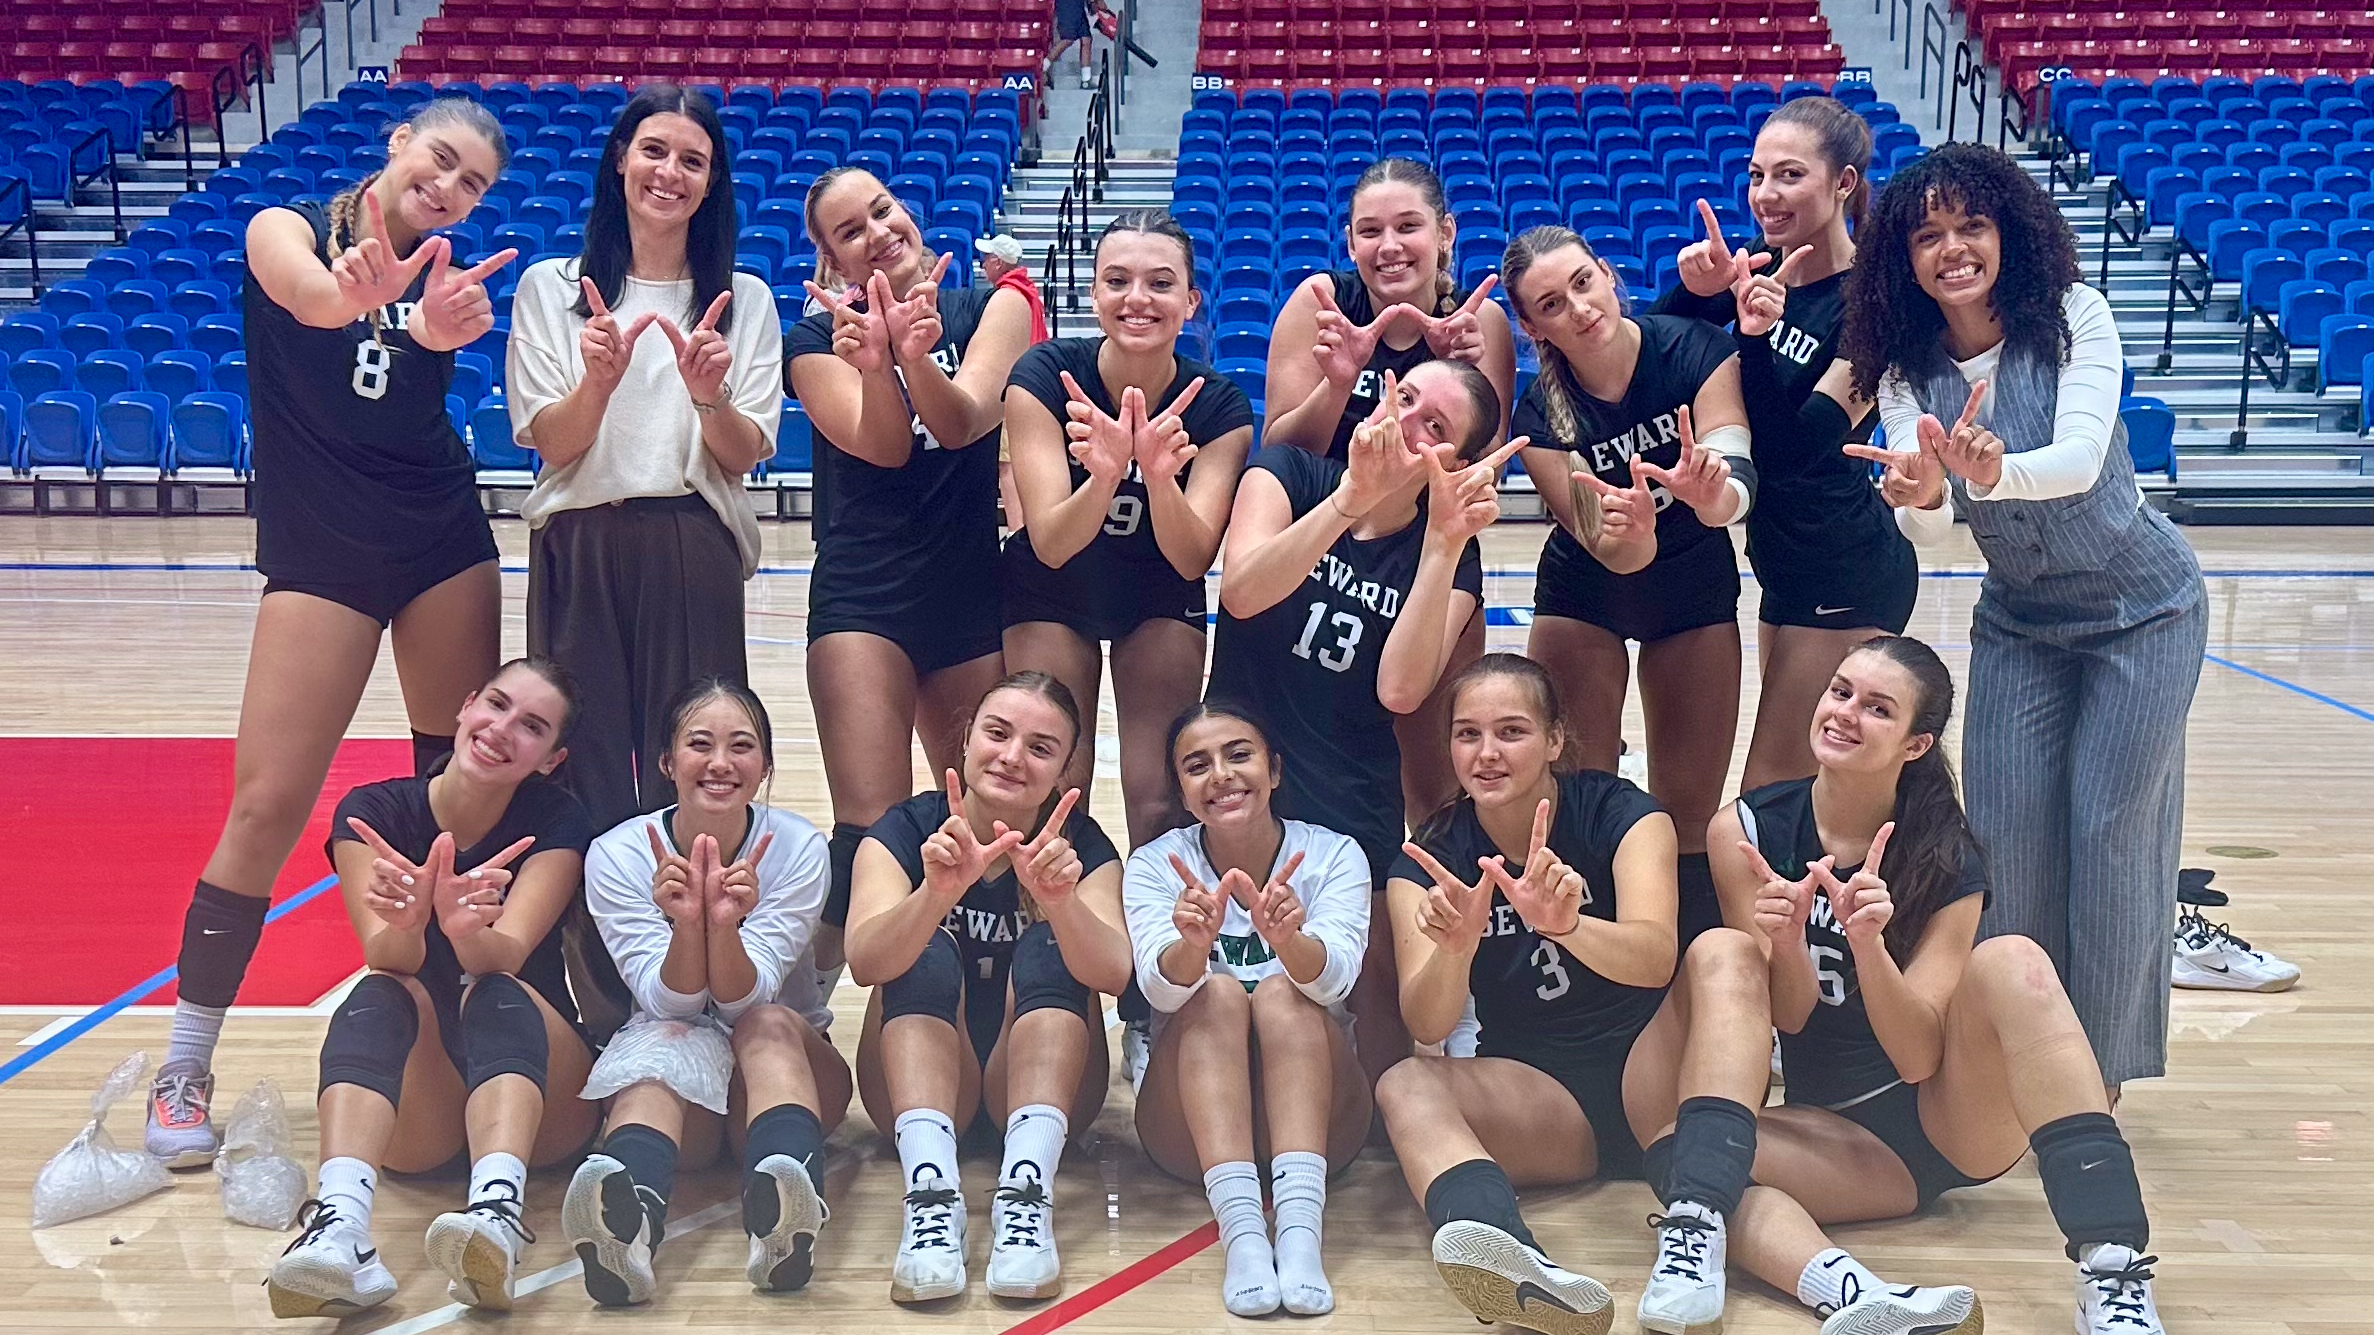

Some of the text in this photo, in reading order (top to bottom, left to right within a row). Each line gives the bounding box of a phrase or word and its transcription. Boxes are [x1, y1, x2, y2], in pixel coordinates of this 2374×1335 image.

[360, 70, 387, 83] AA
[1003, 76, 1033, 90] AA
[1192, 76, 1223, 90] BB
[2039, 67, 2072, 82] CC
[352, 339, 391, 400] 8
[1591, 408, 1681, 473] EWAR
[1103, 495, 1143, 536] 9
[1308, 553, 1400, 619] EWARD
[1291, 601, 1364, 673] 13
[1530, 939, 1571, 1001] 3
